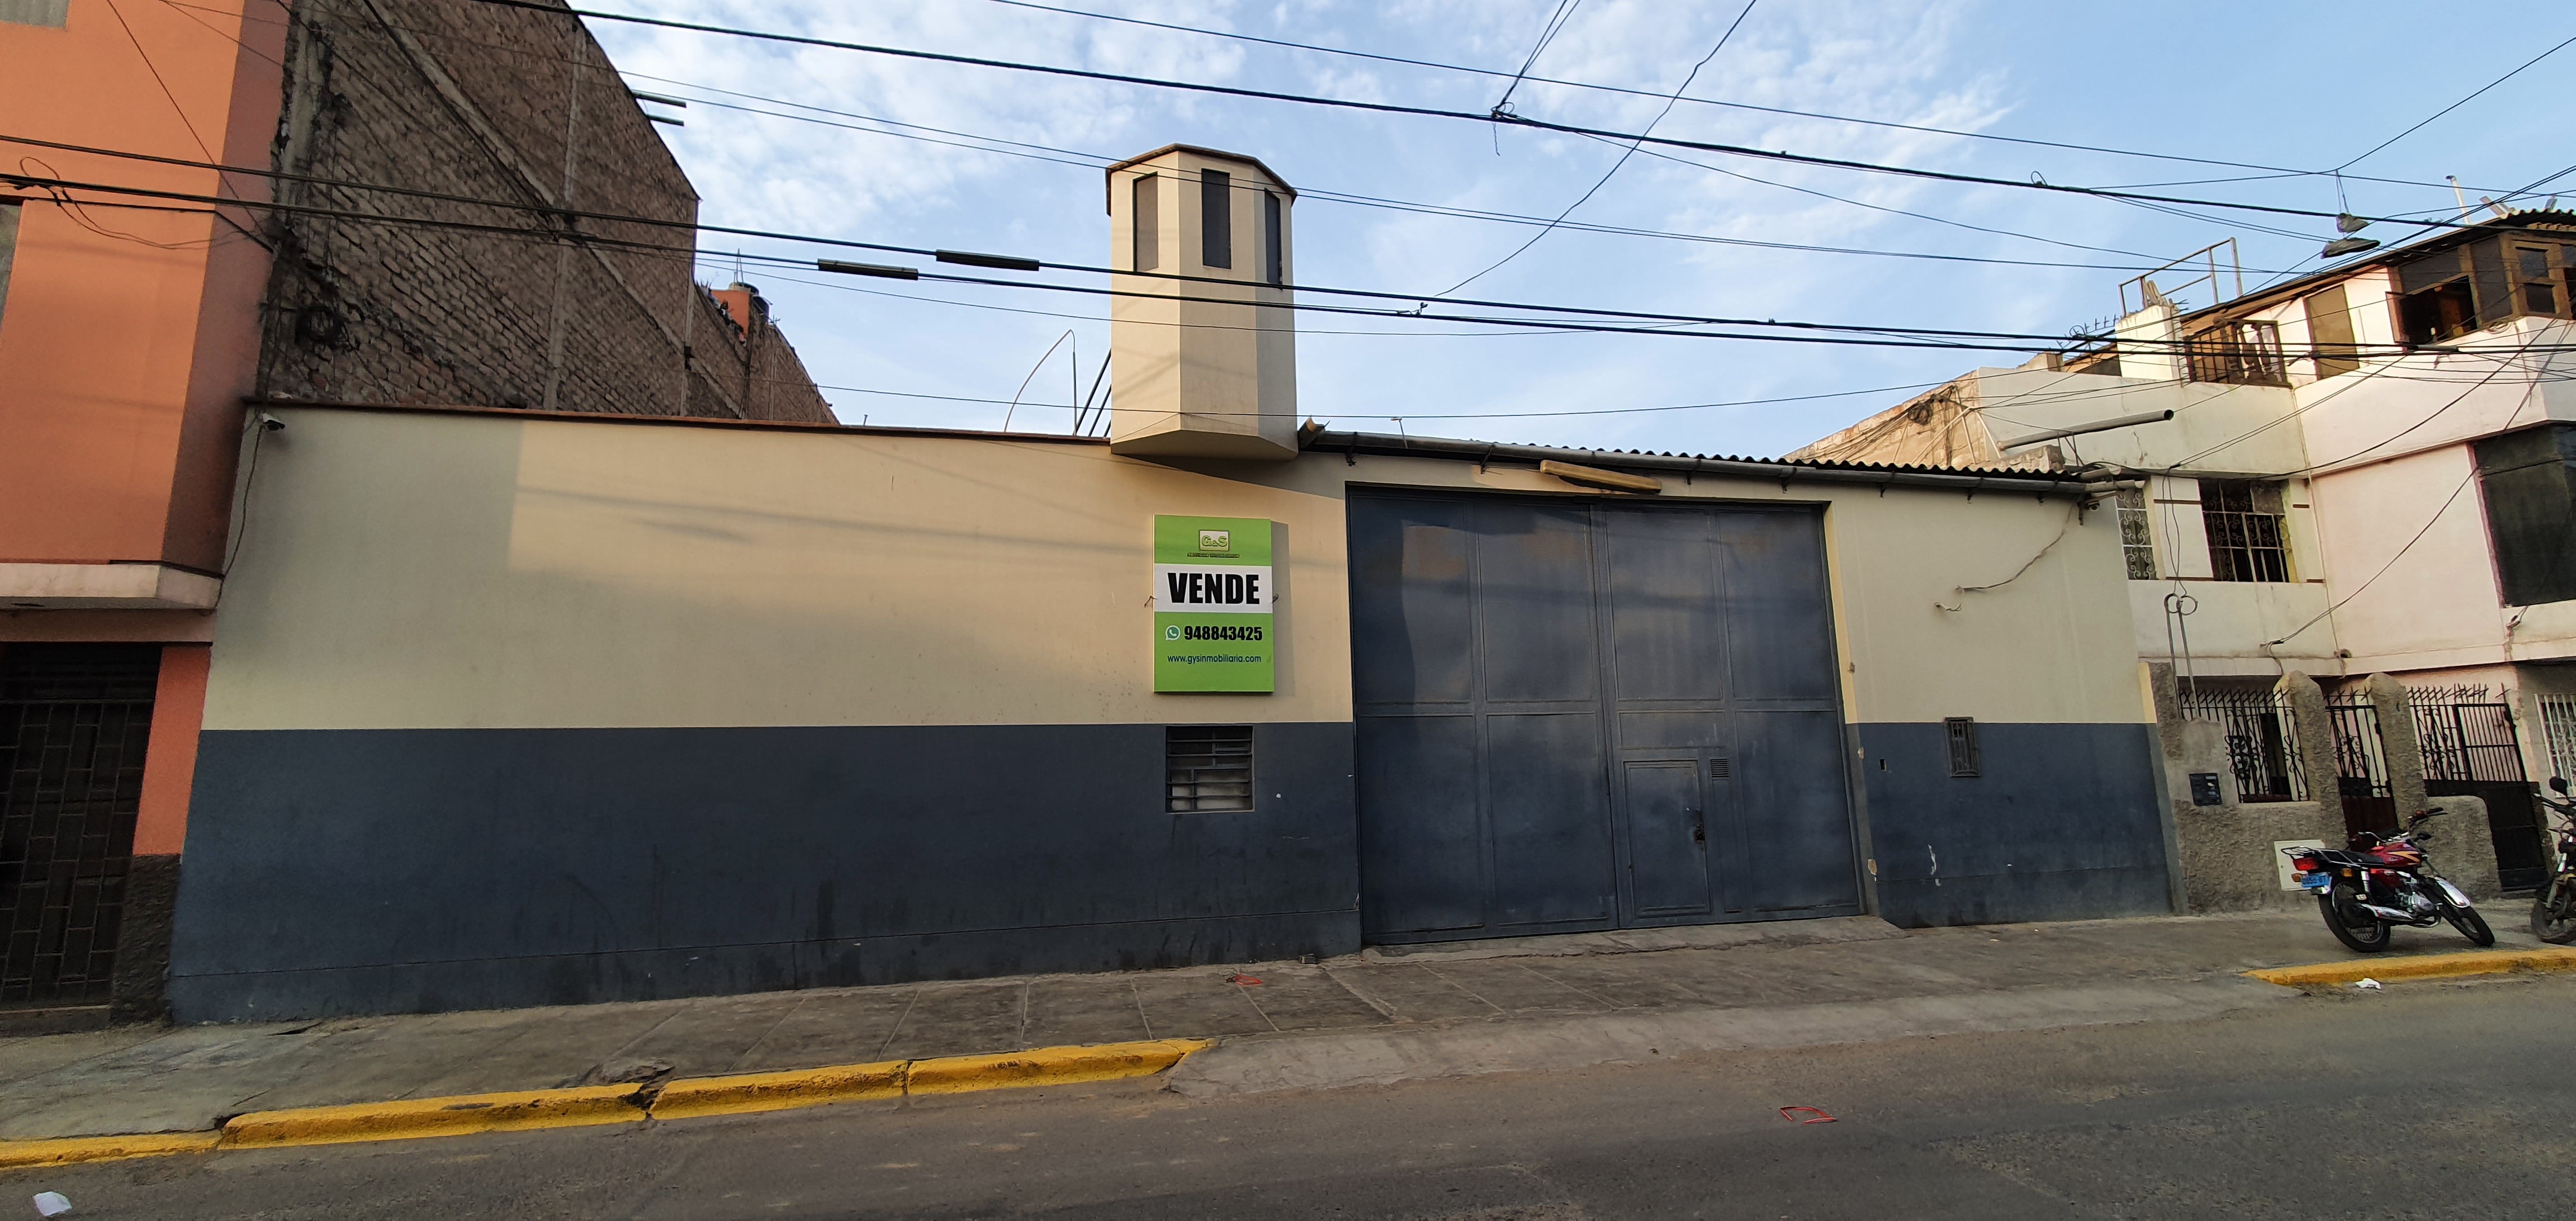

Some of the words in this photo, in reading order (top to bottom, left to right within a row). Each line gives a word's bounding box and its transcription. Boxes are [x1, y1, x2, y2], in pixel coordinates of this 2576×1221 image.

[1201, 534, 1228, 547] G&S
[1167, 572, 1260, 604] VENDE
[1184, 626, 1262, 641] 948843425
[1167, 654, 1262, 665] www.gysinmobiliaria.com
